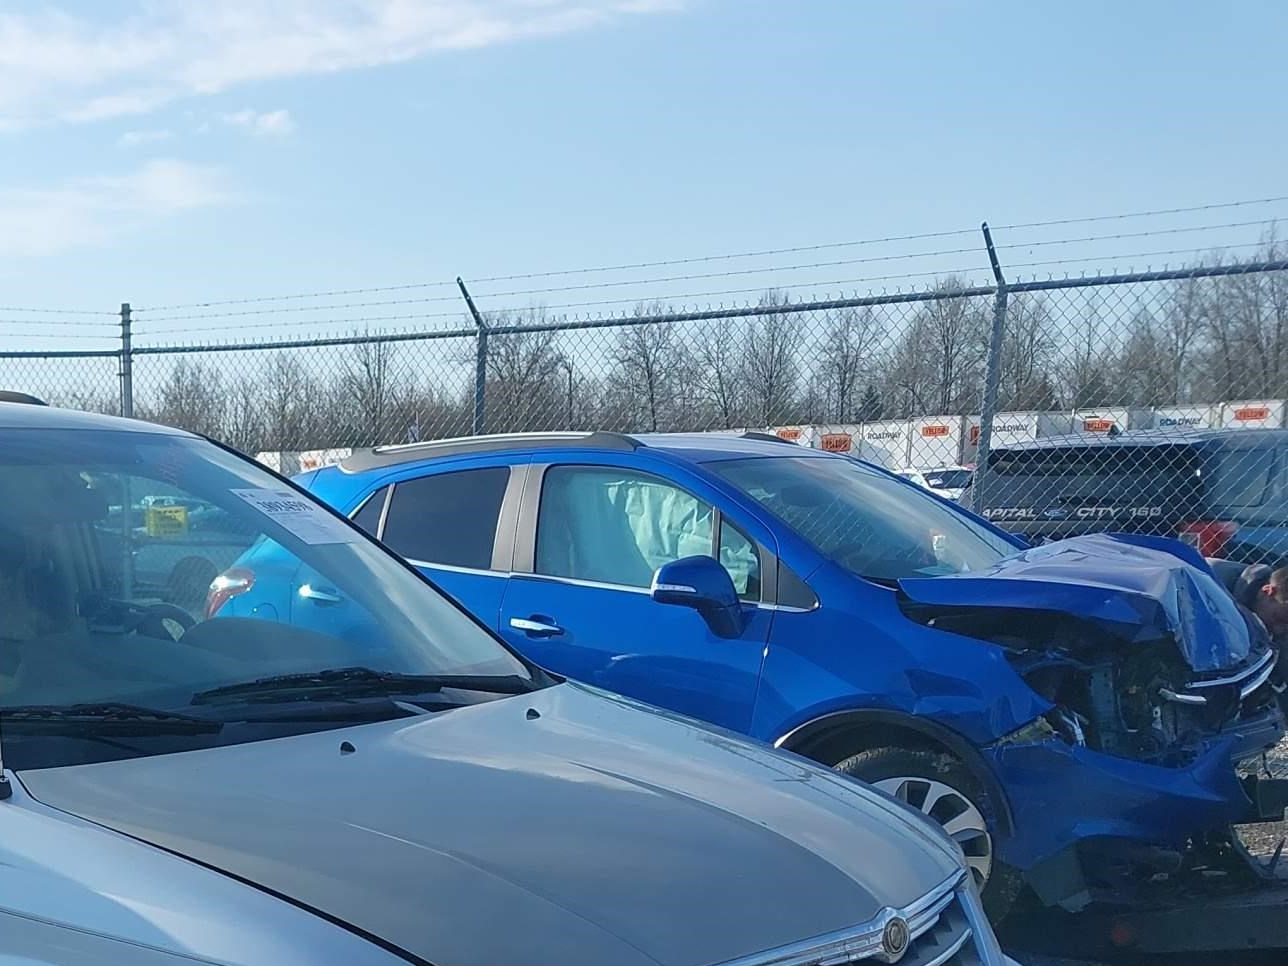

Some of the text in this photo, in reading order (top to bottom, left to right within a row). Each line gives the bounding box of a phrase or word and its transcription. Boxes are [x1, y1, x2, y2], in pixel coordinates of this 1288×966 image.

[1237, 409, 1266, 419] YELLOW
[1160, 417, 1201, 427] ROADWAY
[868, 432, 901, 440] ROADWAY
[982, 509, 1036, 518] APITAL
[1076, 508, 1119, 517] CITY
